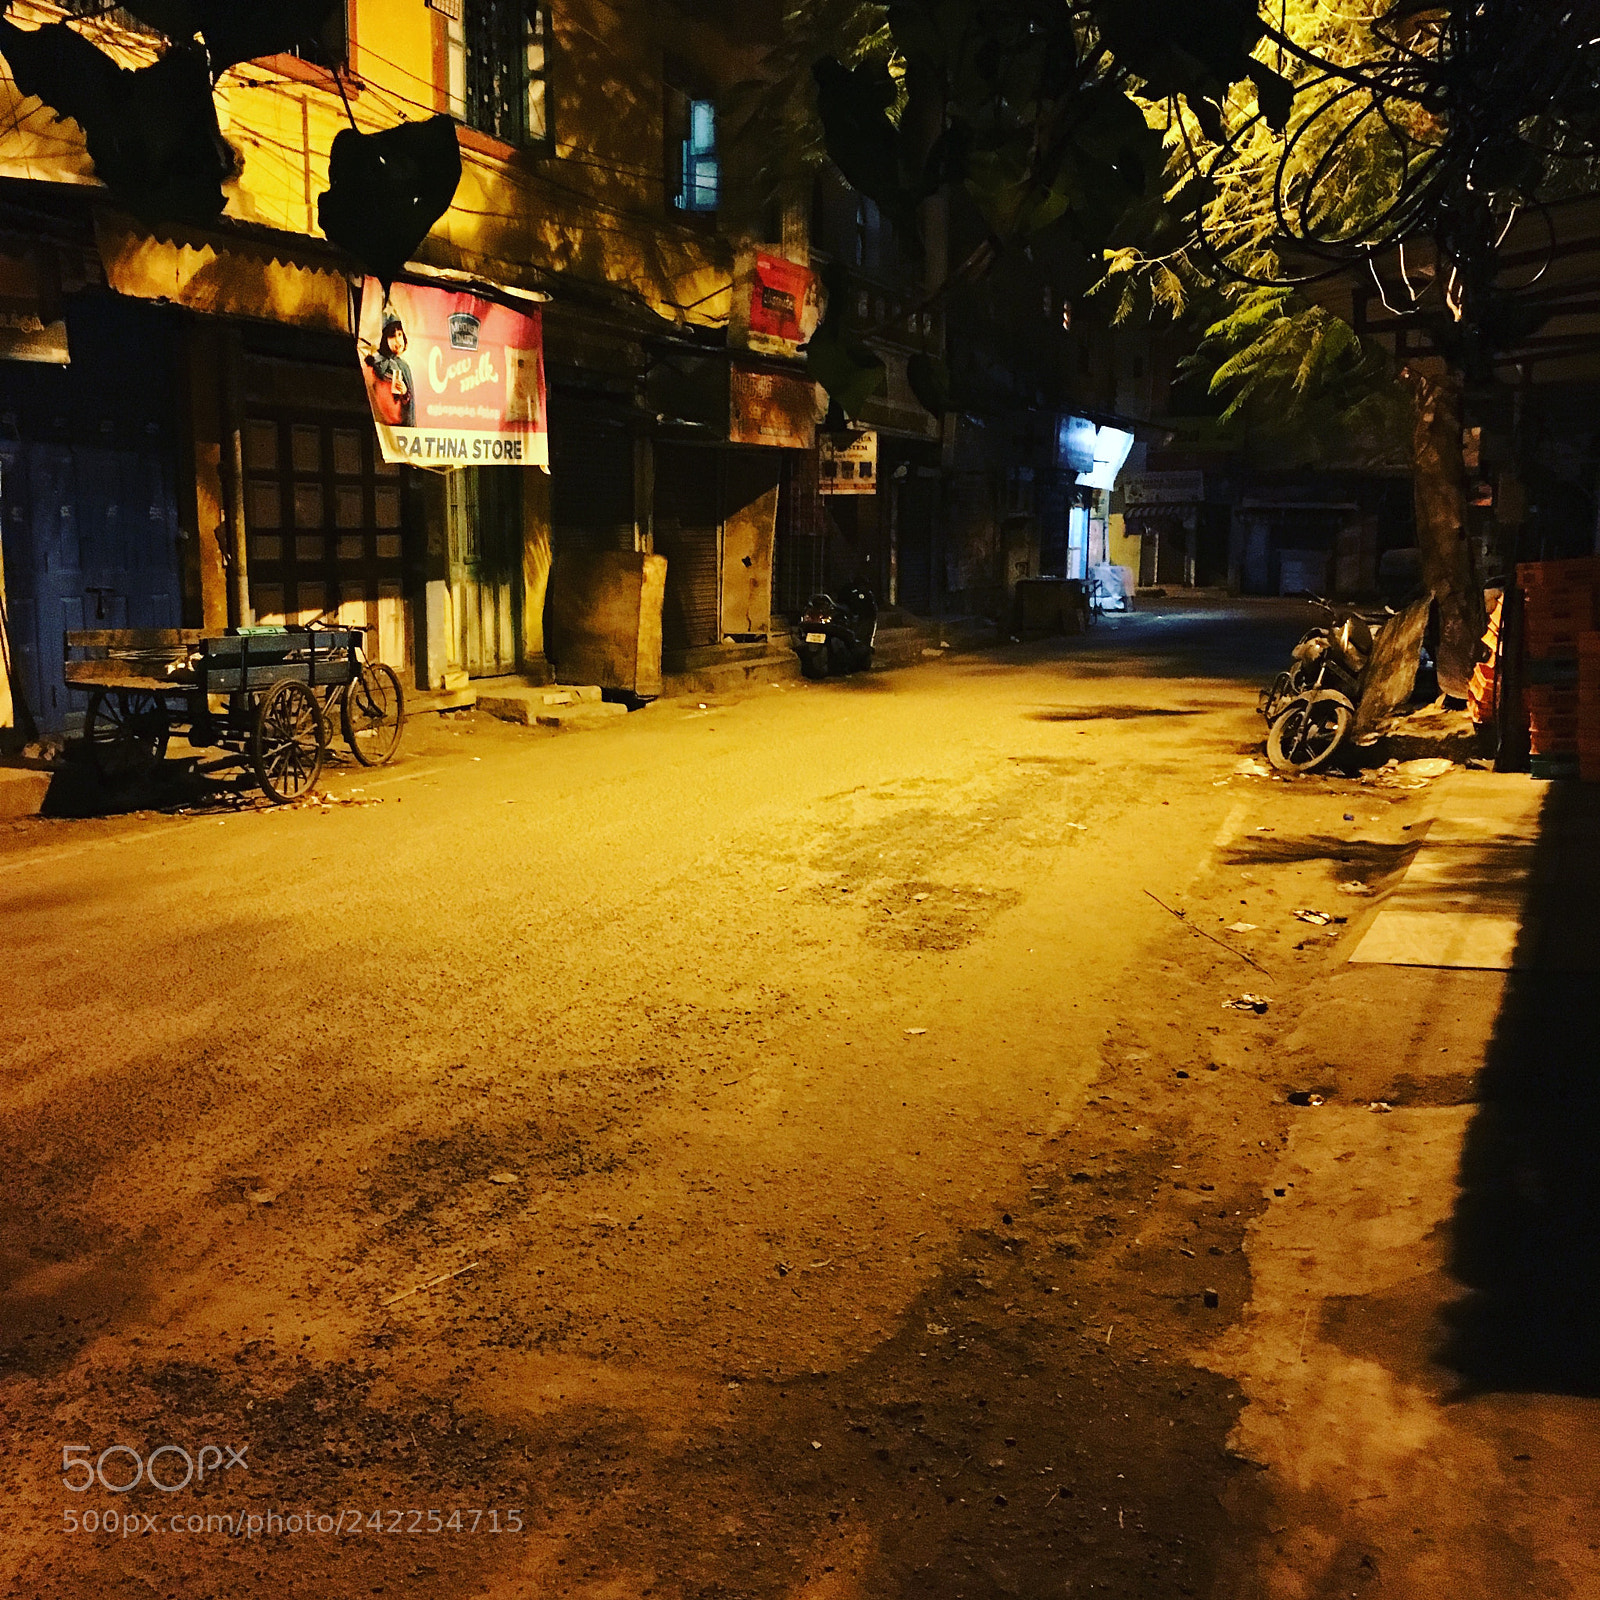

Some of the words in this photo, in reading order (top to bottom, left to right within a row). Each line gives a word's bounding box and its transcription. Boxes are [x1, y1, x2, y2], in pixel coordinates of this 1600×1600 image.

[428, 345, 471, 394] Cow
[460, 352, 499, 393] milk
[396, 435, 468, 459] RATHNA
[472, 438, 522, 460] STORE
